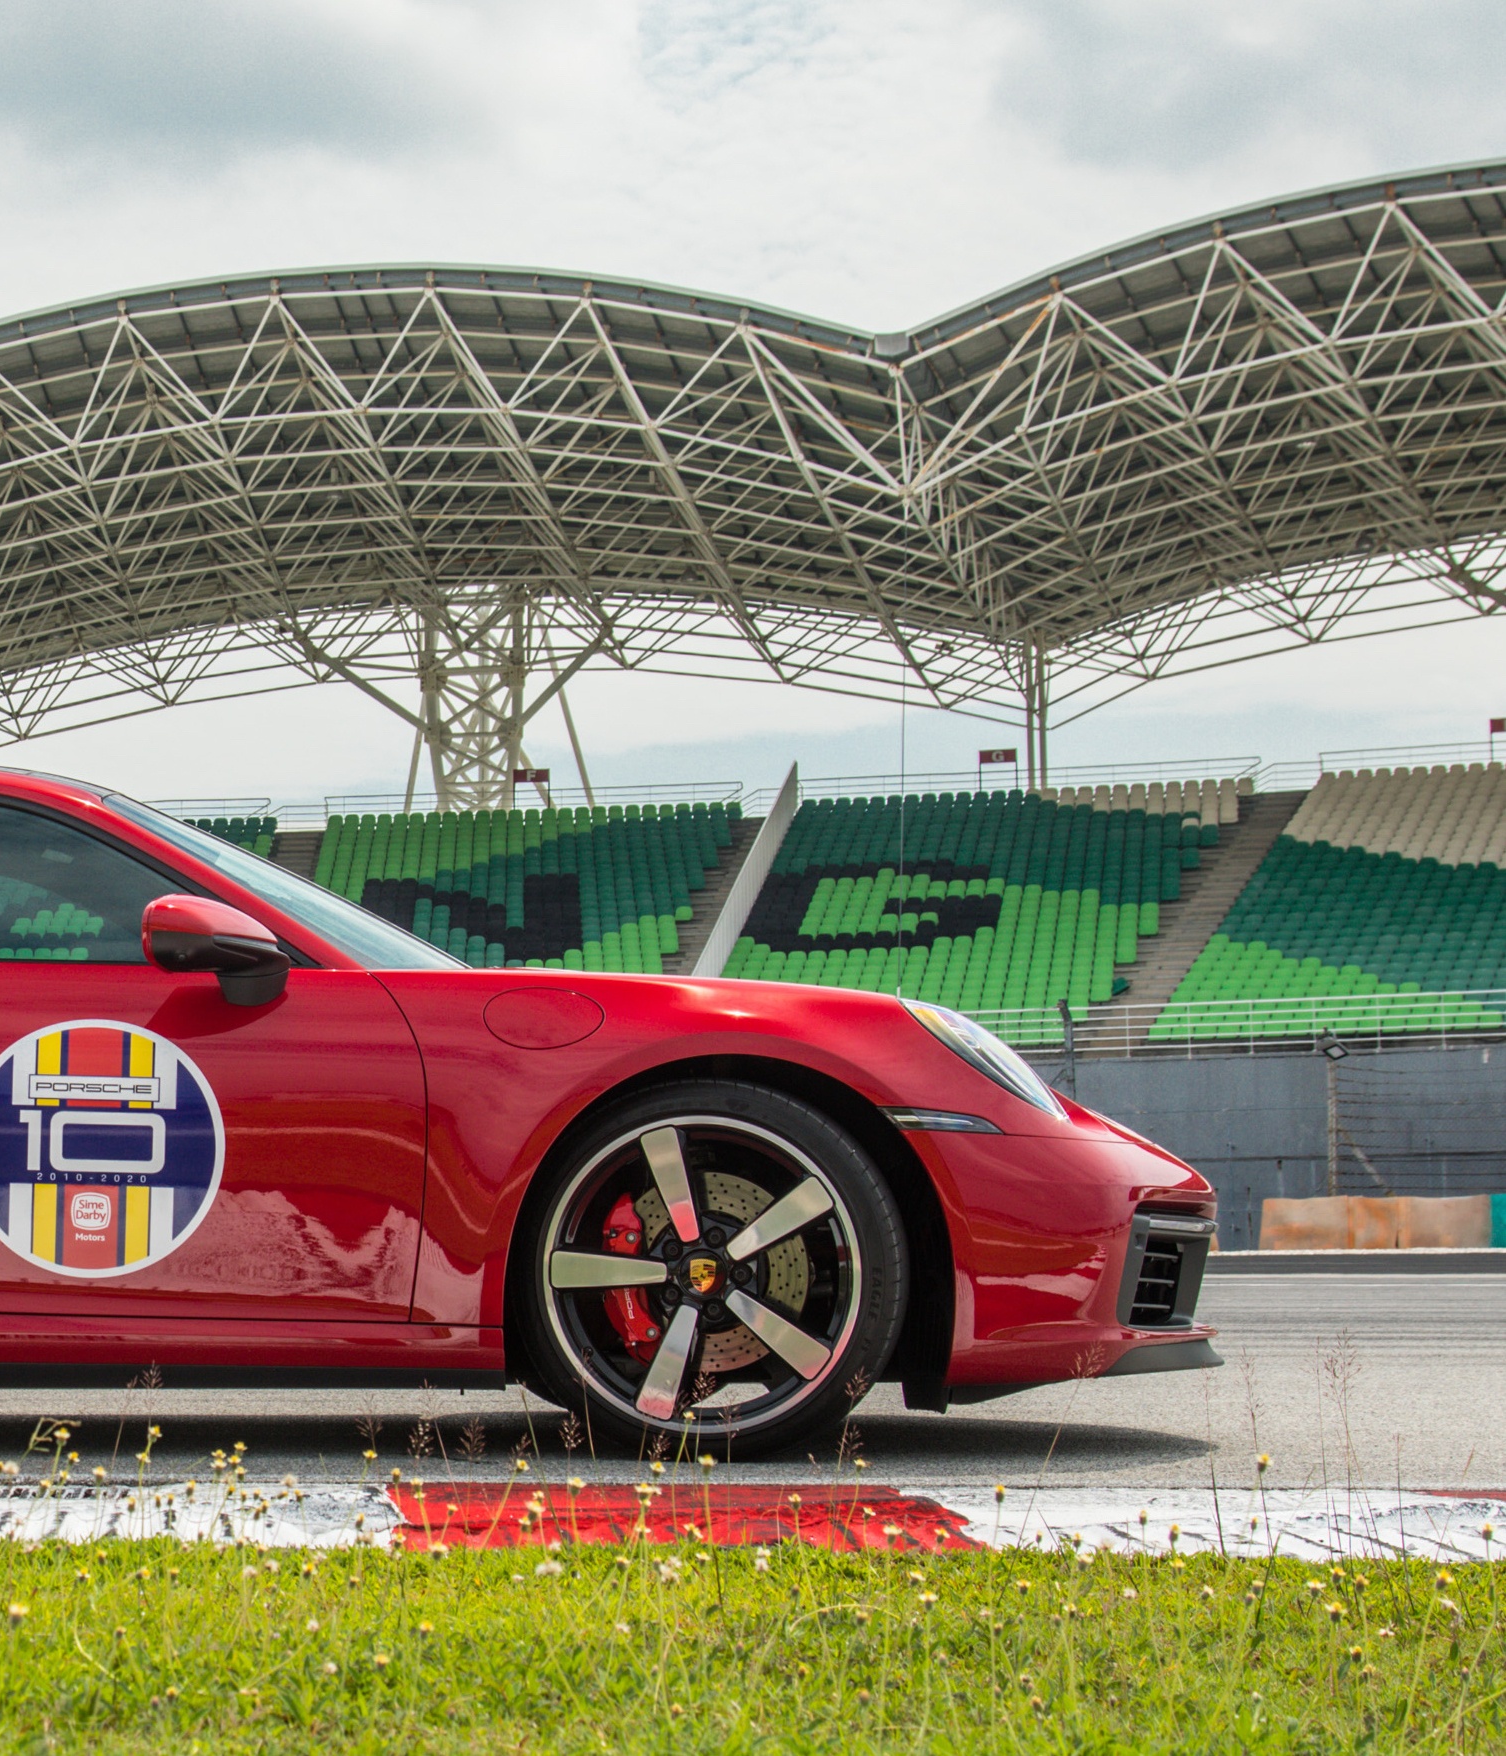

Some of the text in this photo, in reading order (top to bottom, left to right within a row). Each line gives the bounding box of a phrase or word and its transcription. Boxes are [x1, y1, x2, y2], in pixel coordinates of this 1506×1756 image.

[991, 750, 1004, 762] G
[526, 770, 537, 782] F
[35, 1082, 152, 1094] PORSCHE
[19, 1109, 166, 1174] 10
[78, 1199, 104, 1209] Sime
[75, 1209, 107, 1222] Darby
[75, 1232, 105, 1241] Motors
